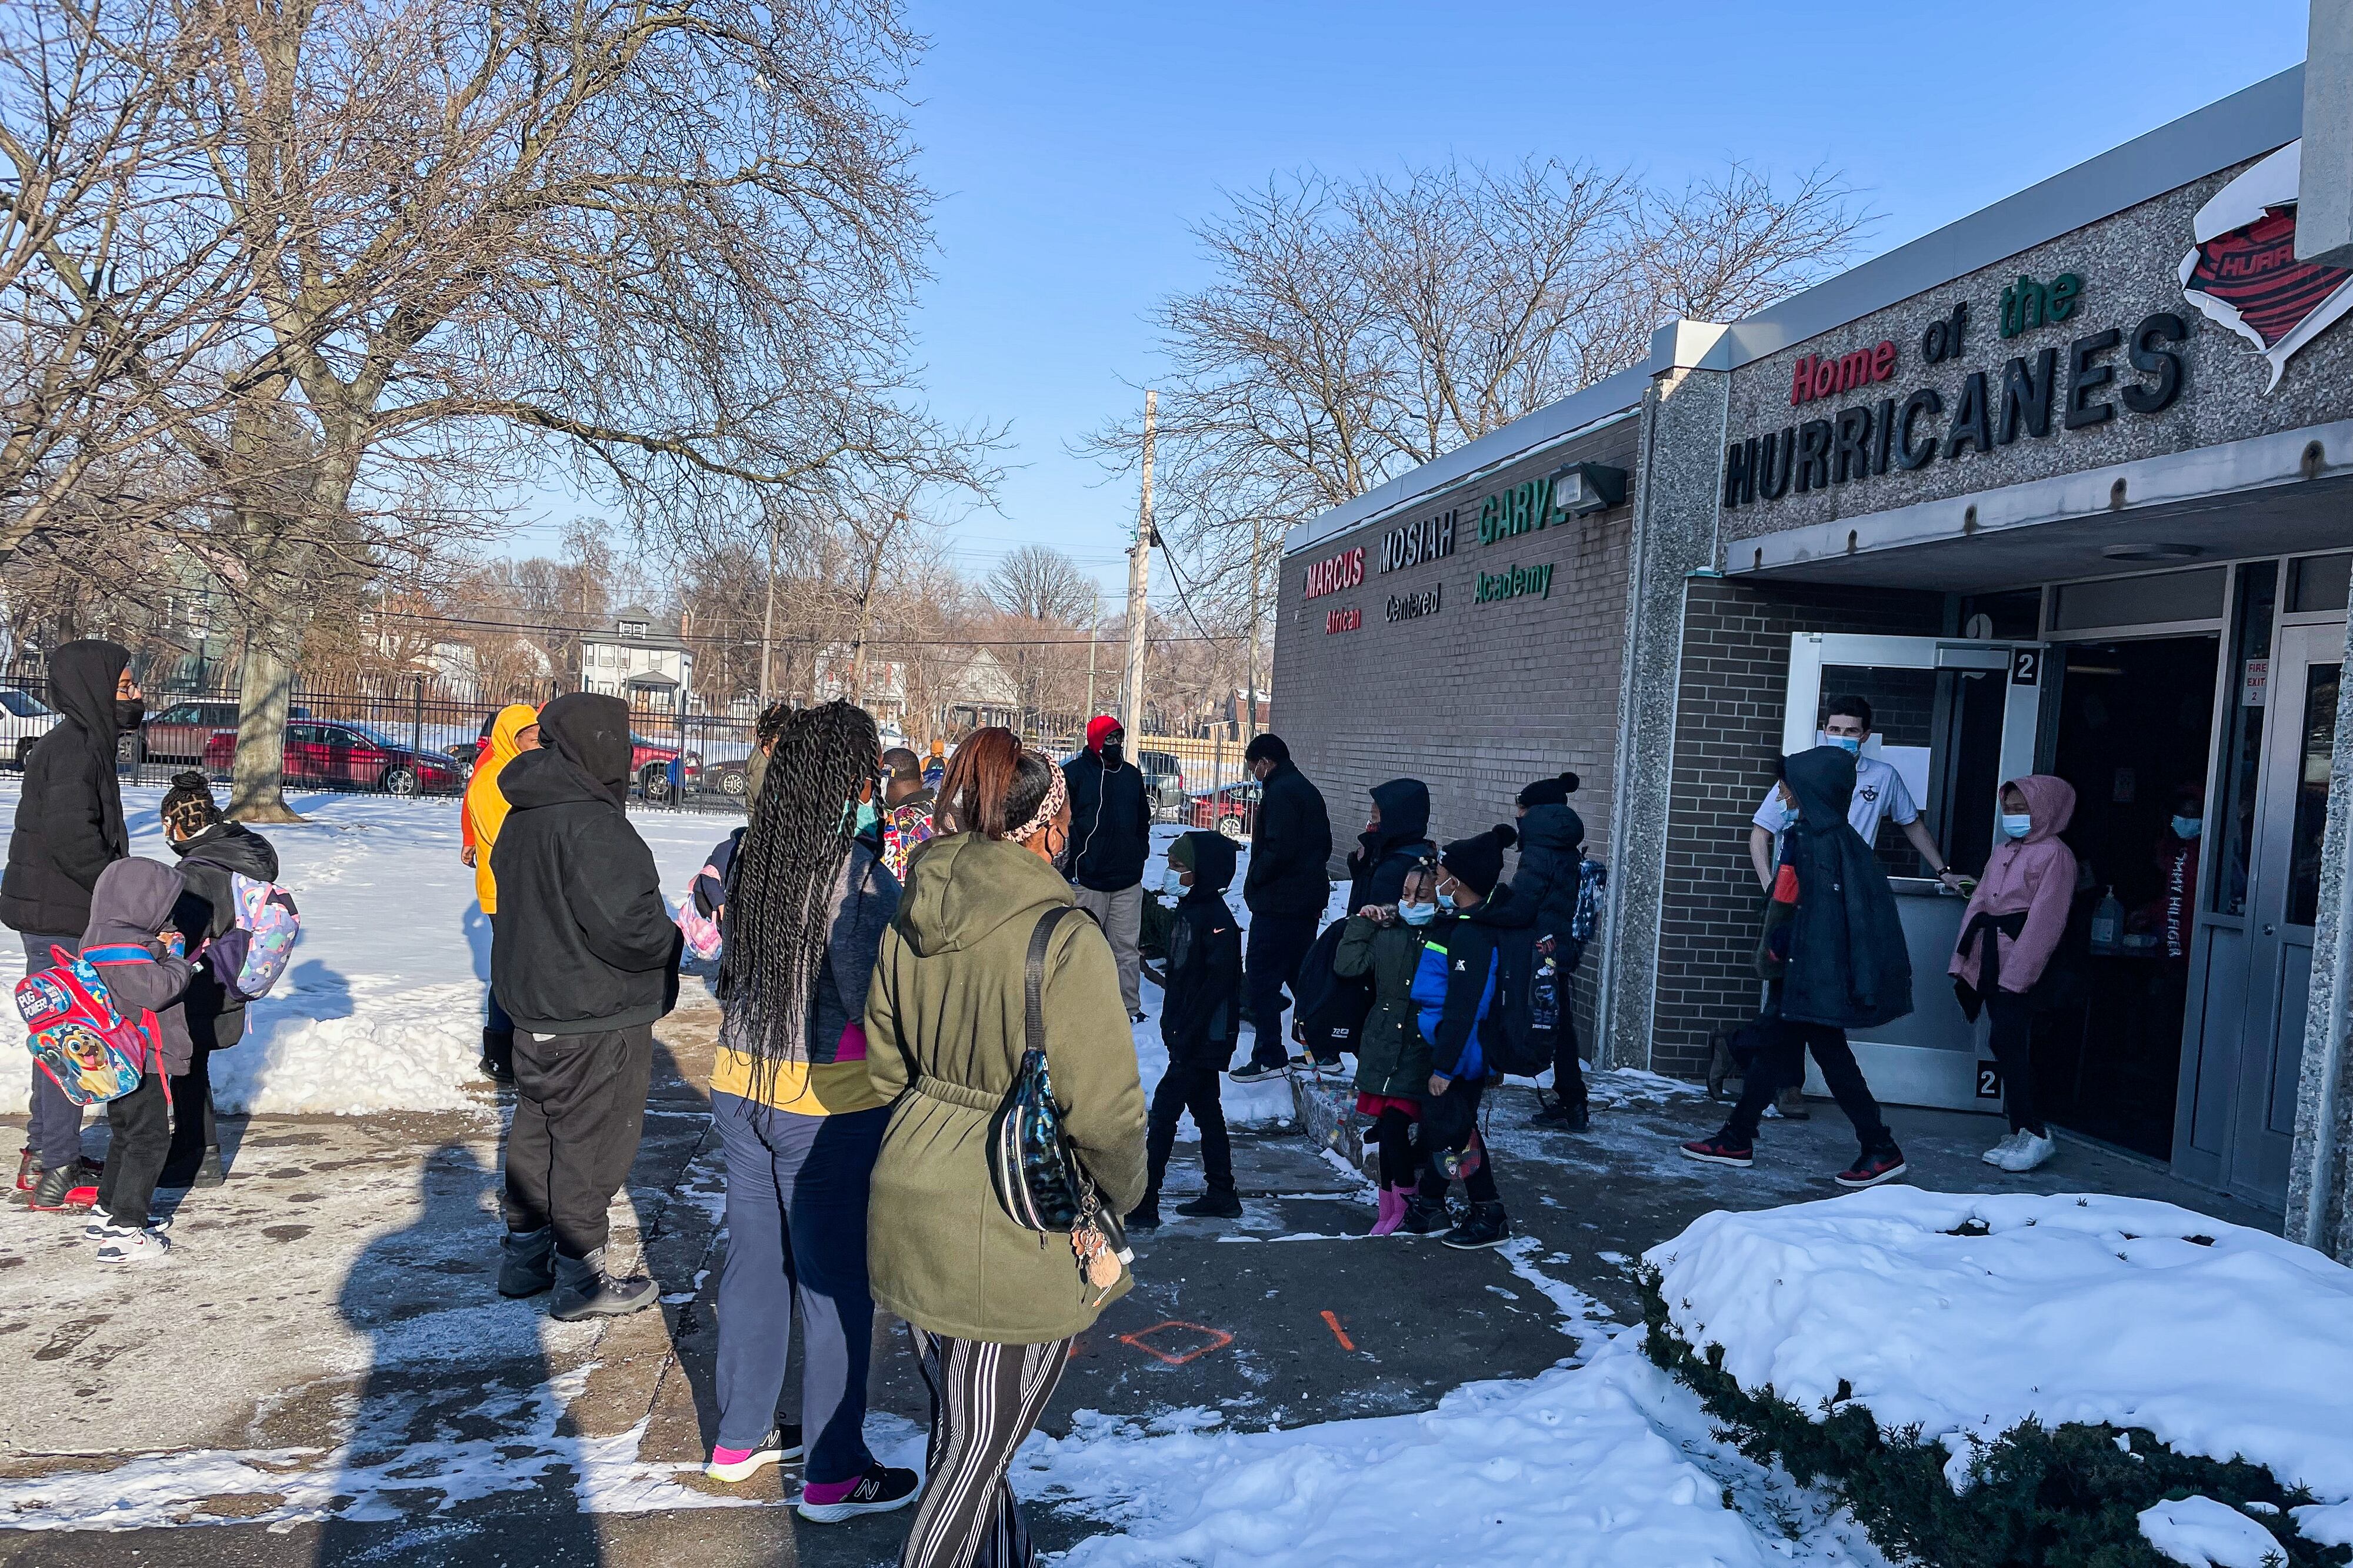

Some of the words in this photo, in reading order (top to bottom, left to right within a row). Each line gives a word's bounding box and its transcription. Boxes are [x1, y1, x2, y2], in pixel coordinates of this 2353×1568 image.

[1790, 341, 1897, 406] Home
[1921, 301, 1967, 364] of
[2001, 273, 2080, 339] the
[1724, 312, 2187, 508] HURRICANES
[1305, 546, 1365, 599] MARCUS
[1378, 509, 1458, 574] MOSIAH
[1325, 606, 1362, 635] African
[1385, 582, 1441, 623] Centered
[1475, 563, 1555, 605] Academy
[2018, 654, 2034, 678] 2
[2248, 663, 2268, 673] FIRE
[2247, 677, 2265, 687] EXIT
[2251, 692, 2257, 700] 2
[17, 990, 35, 1008] PUG
[24, 997, 48, 1019] POWER!
[1981, 1070, 1995, 1093] 2
